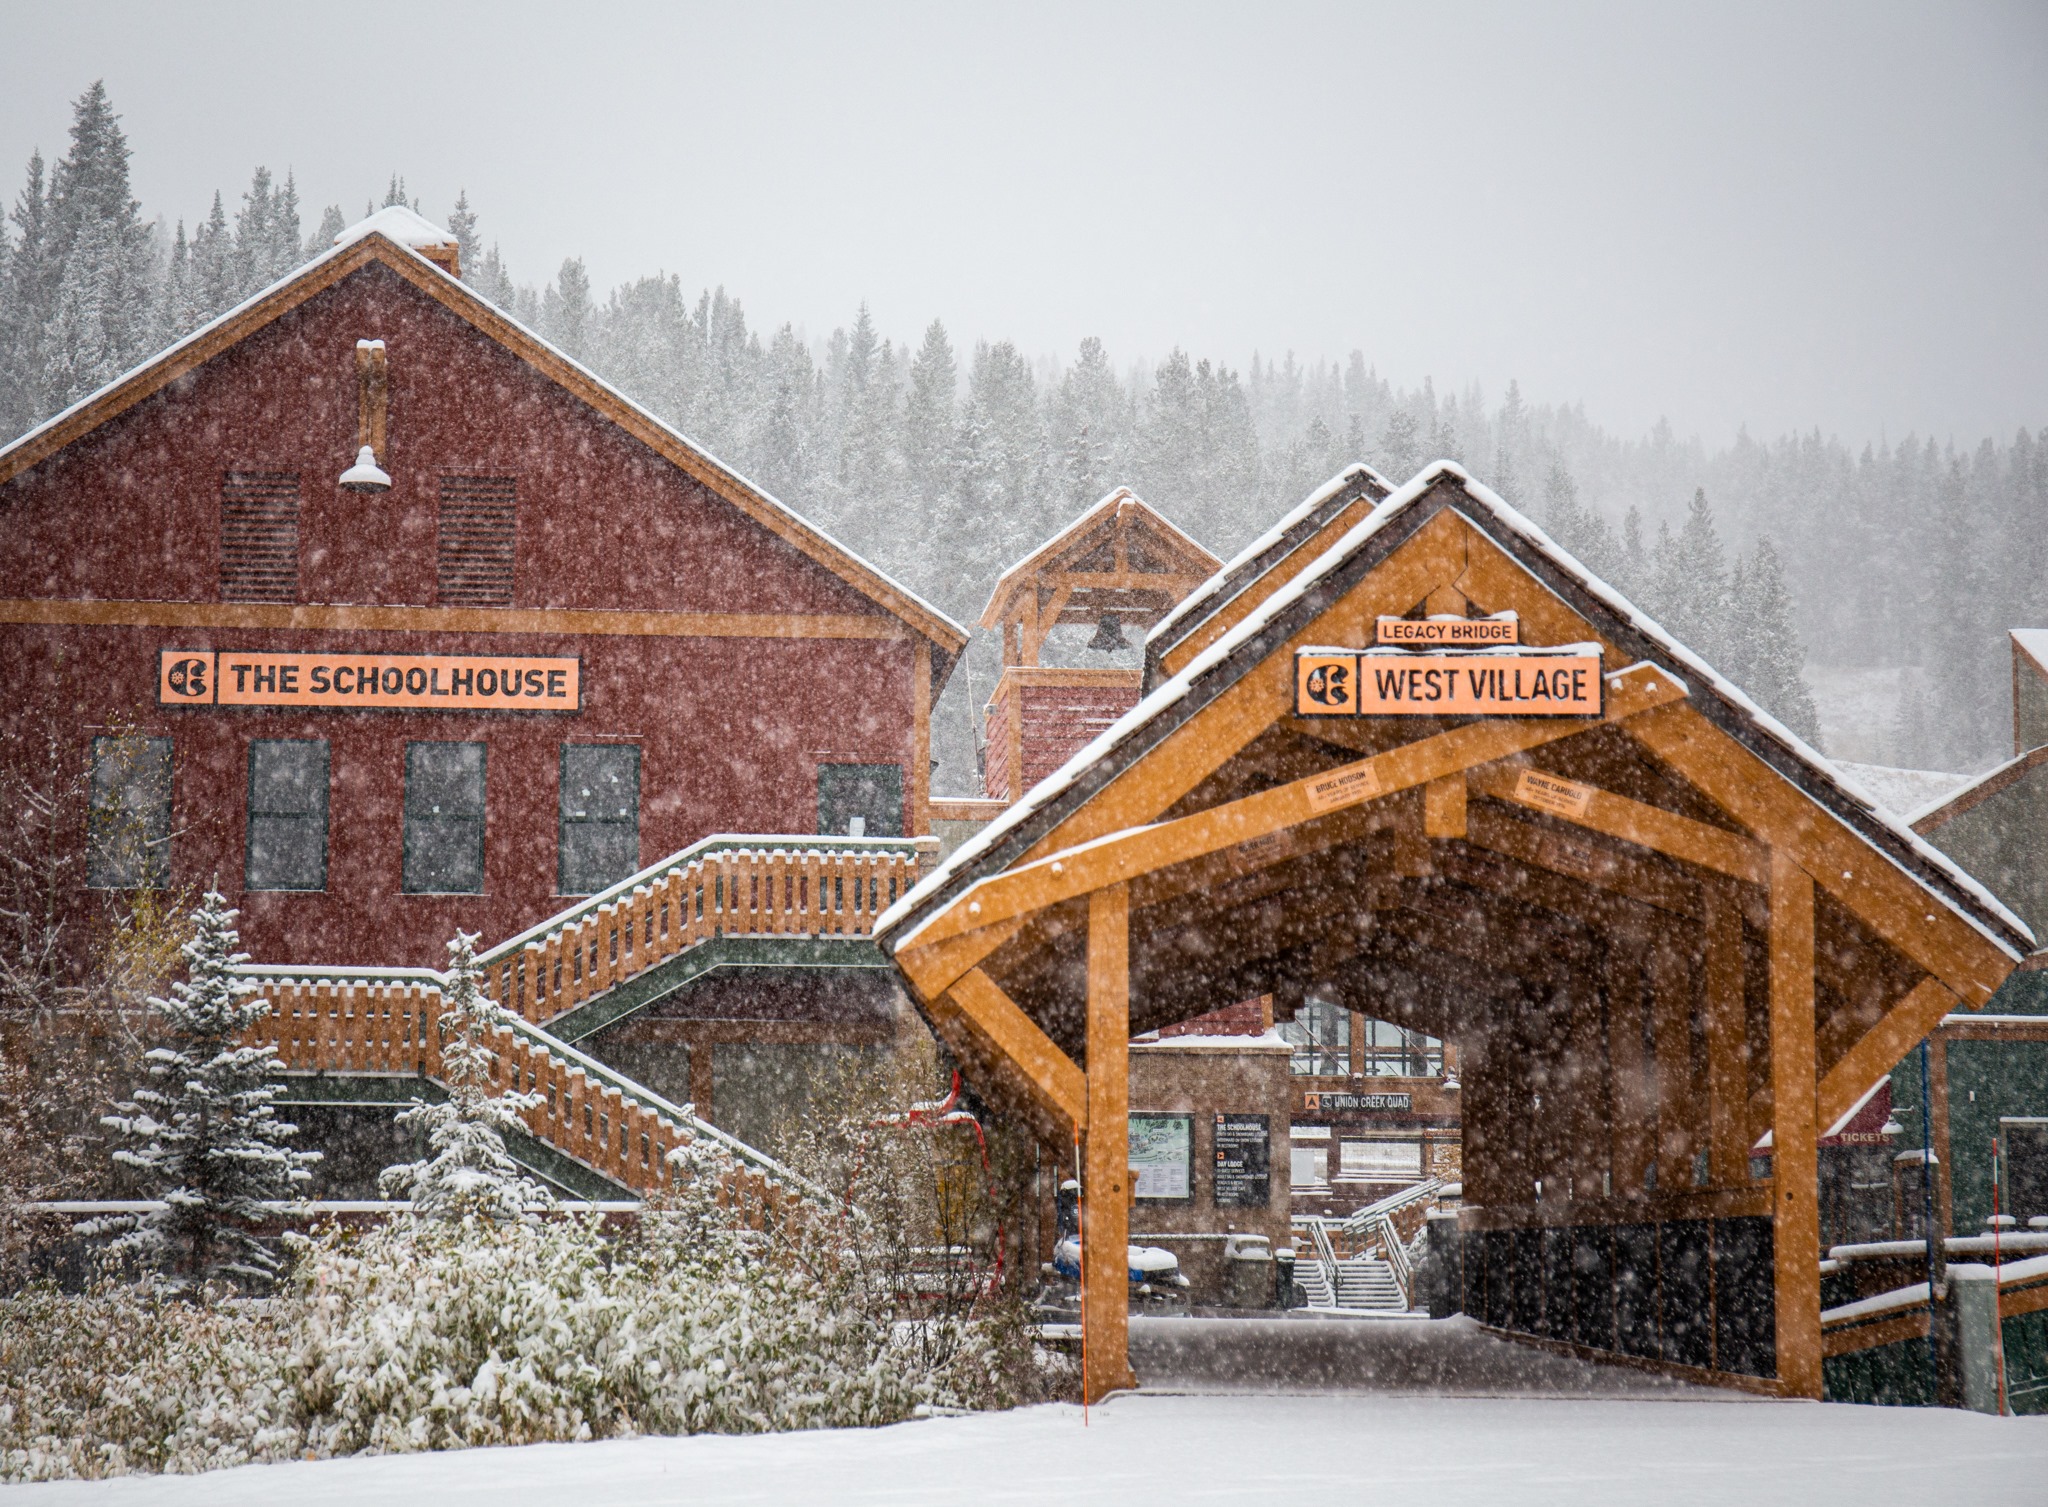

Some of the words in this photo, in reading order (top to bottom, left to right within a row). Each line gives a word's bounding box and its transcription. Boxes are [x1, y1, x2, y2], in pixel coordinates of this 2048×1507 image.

[1384, 625, 1445, 639] LEGACY
[1451, 625, 1512, 639] BRIDGE
[230, 664, 299, 693] THE
[309, 665, 567, 698] SCHOOLHOUSE
[1375, 669, 1460, 702] WEST
[1468, 669, 1588, 702] VILLAGE
[1339, 770, 1367, 785] HODSON
[1527, 775, 1551, 790] WAYNE
[1334, 1096, 1359, 1108] UNION
[1361, 1096, 1385, 1108] CREEK
[1387, 1096, 1409, 1108] QUAD
[1217, 1123, 1226, 1131] THE
[1227, 1122, 1261, 1131] SCHOOLHOUSE
[1840, 1133, 1890, 1142] TICKETS
[1217, 1160, 1227, 1168] DAY
[1227, 1160, 1243, 1168] LODGE
